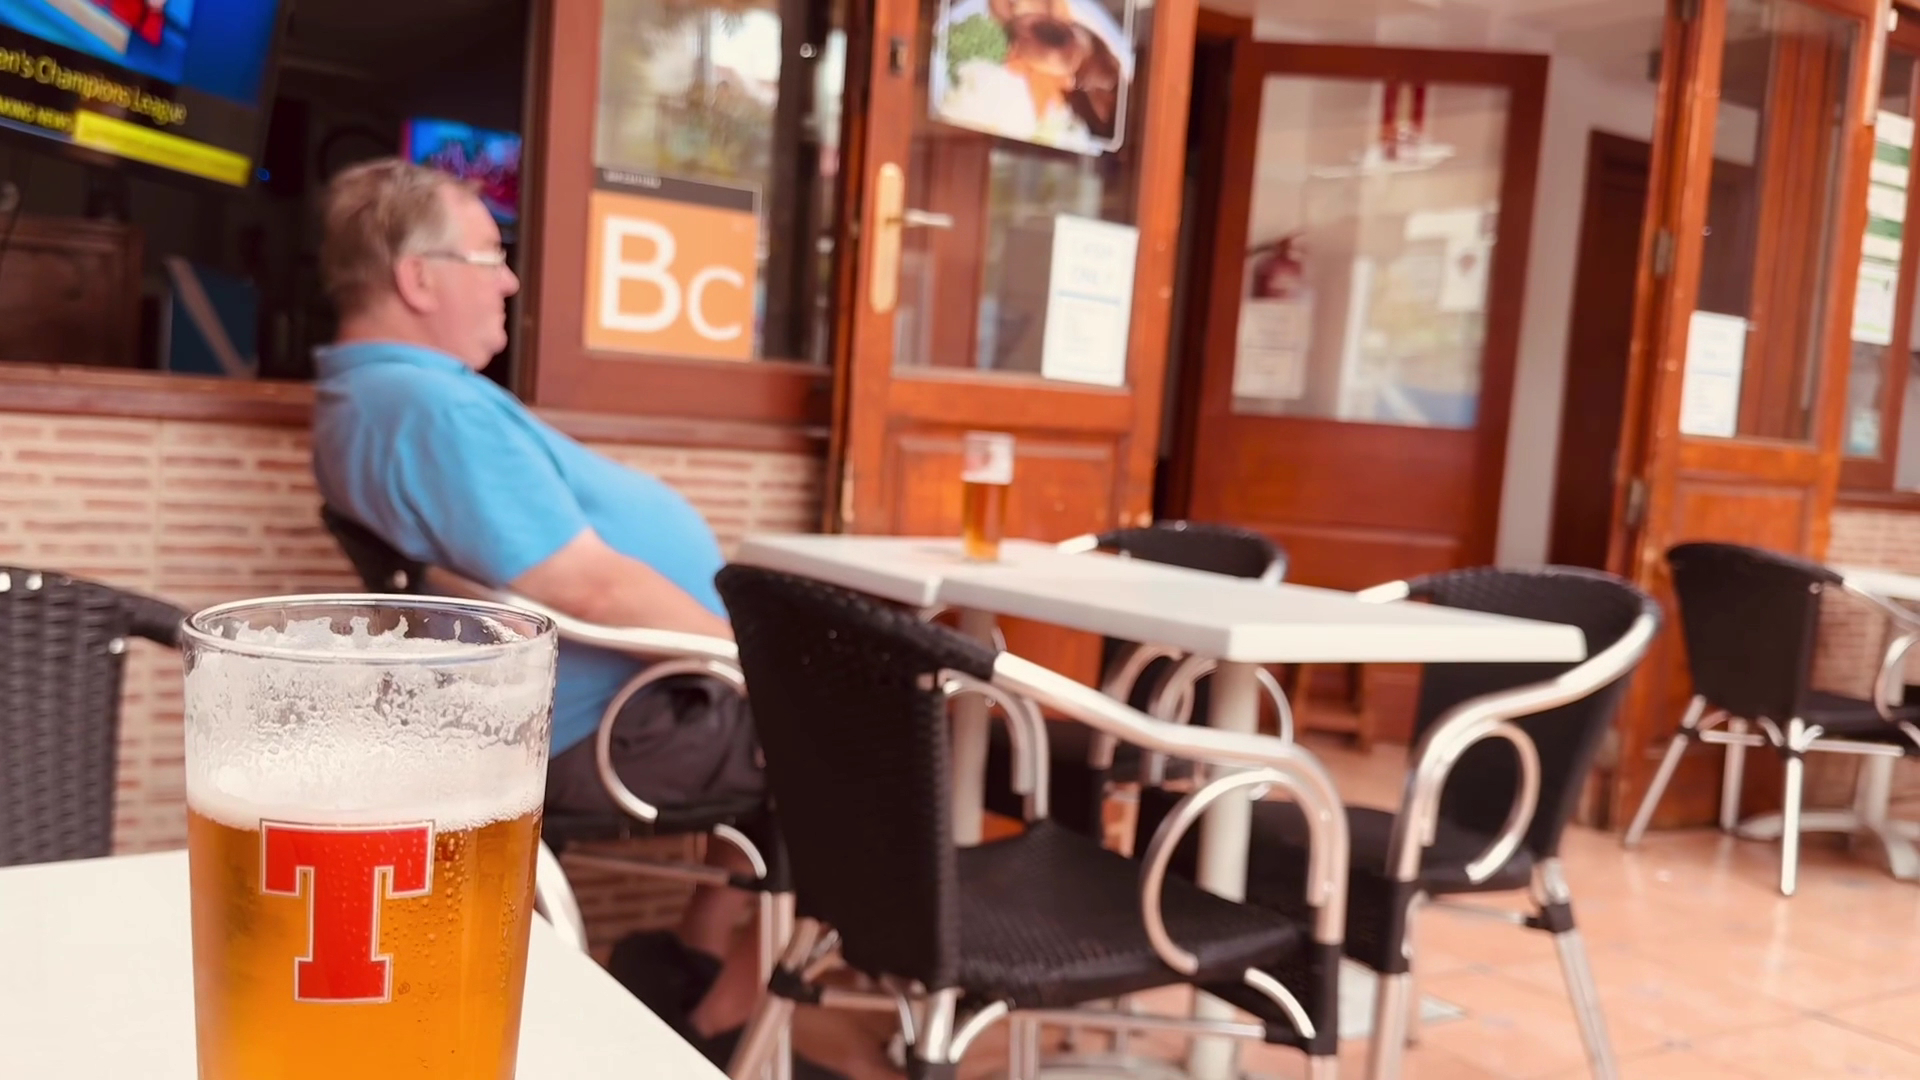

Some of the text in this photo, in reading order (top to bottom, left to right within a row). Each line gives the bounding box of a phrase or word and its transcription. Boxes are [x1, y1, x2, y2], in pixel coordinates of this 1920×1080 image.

[35, 55, 132, 108] Champions
[132, 85, 187, 126] League
[601, 213, 745, 341] Bc
[260, 818, 434, 1004] T
